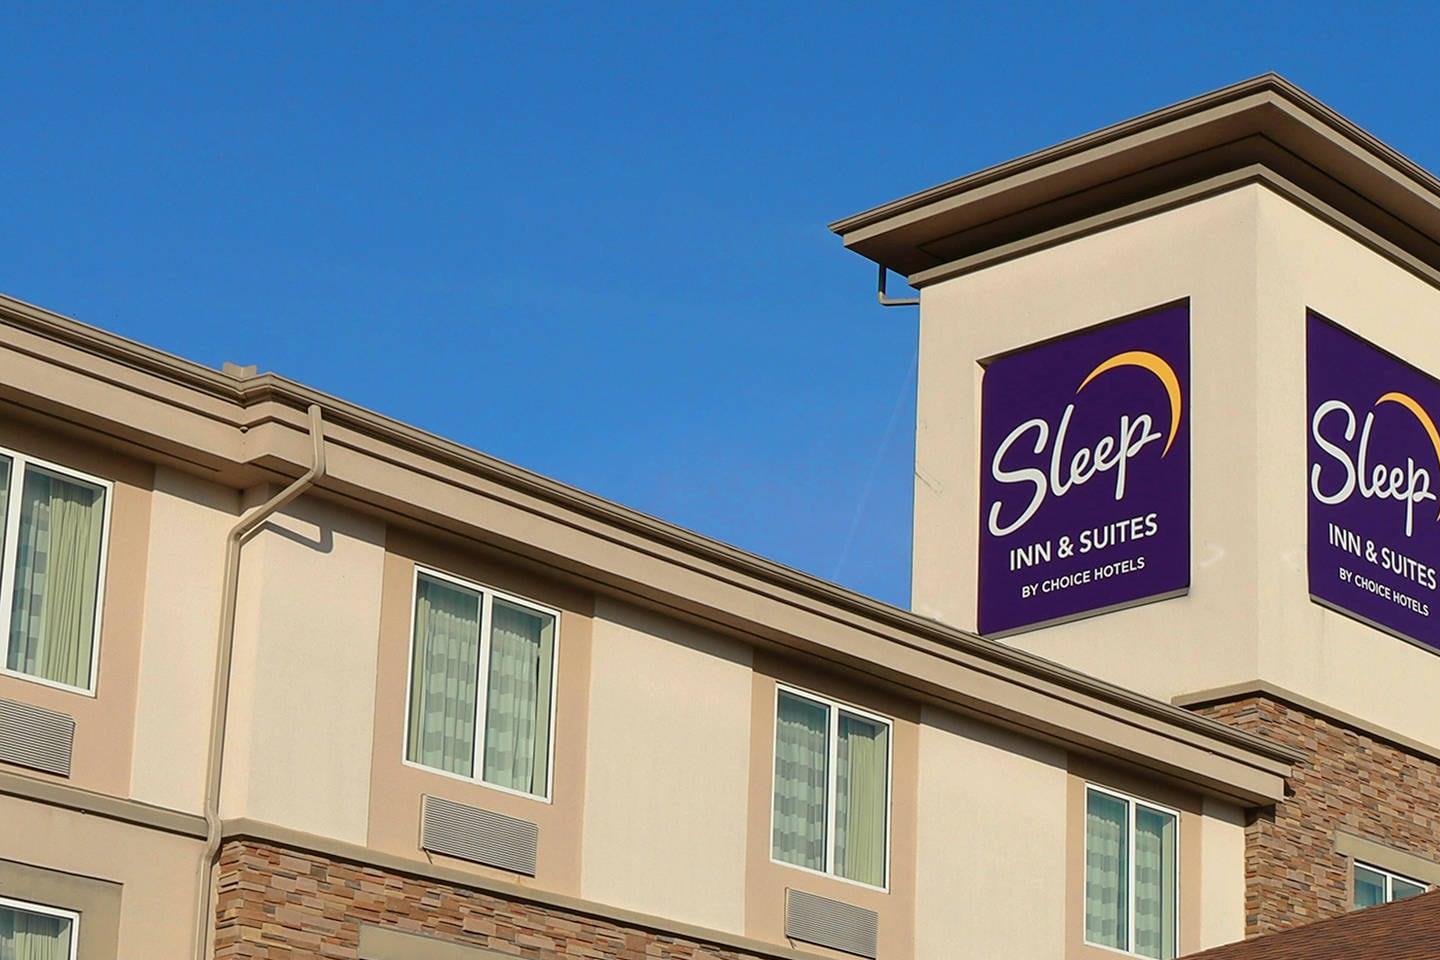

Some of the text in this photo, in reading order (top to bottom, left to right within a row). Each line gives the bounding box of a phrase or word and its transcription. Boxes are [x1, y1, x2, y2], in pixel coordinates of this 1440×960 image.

[987, 403, 1162, 537] Sleep
[1310, 399, 1437, 537] Sleep
[1010, 513, 1158, 571] INN & SUITES
[1328, 522, 1437, 590] INN & SUITES
[1022, 556, 1145, 599] BY CHOICE HOTELS
[1339, 567, 1429, 617] BY CHOICE HOTELS
